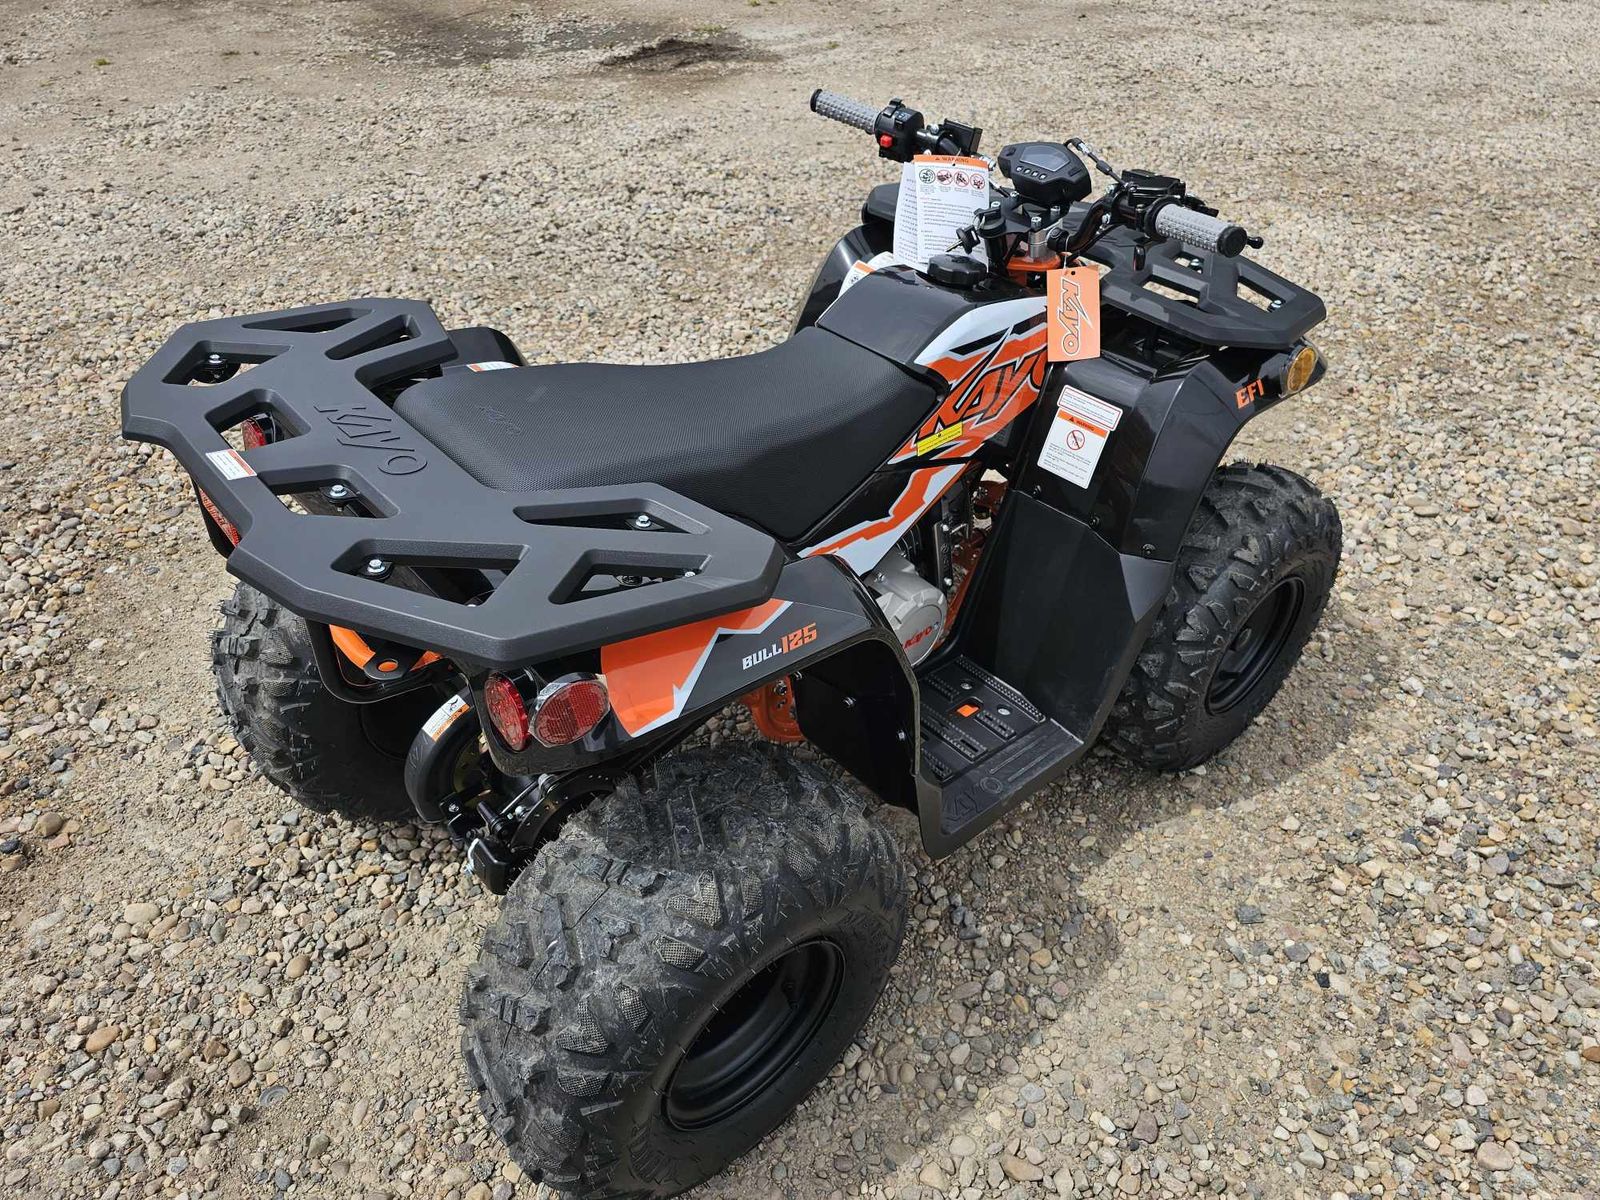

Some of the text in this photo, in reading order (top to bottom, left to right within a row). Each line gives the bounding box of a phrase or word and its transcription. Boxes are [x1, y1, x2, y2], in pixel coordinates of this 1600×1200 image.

[1057, 277, 1094, 355] KAYO
[1236, 379, 1264, 409] EFI
[313, 404, 428, 476] KAYO
